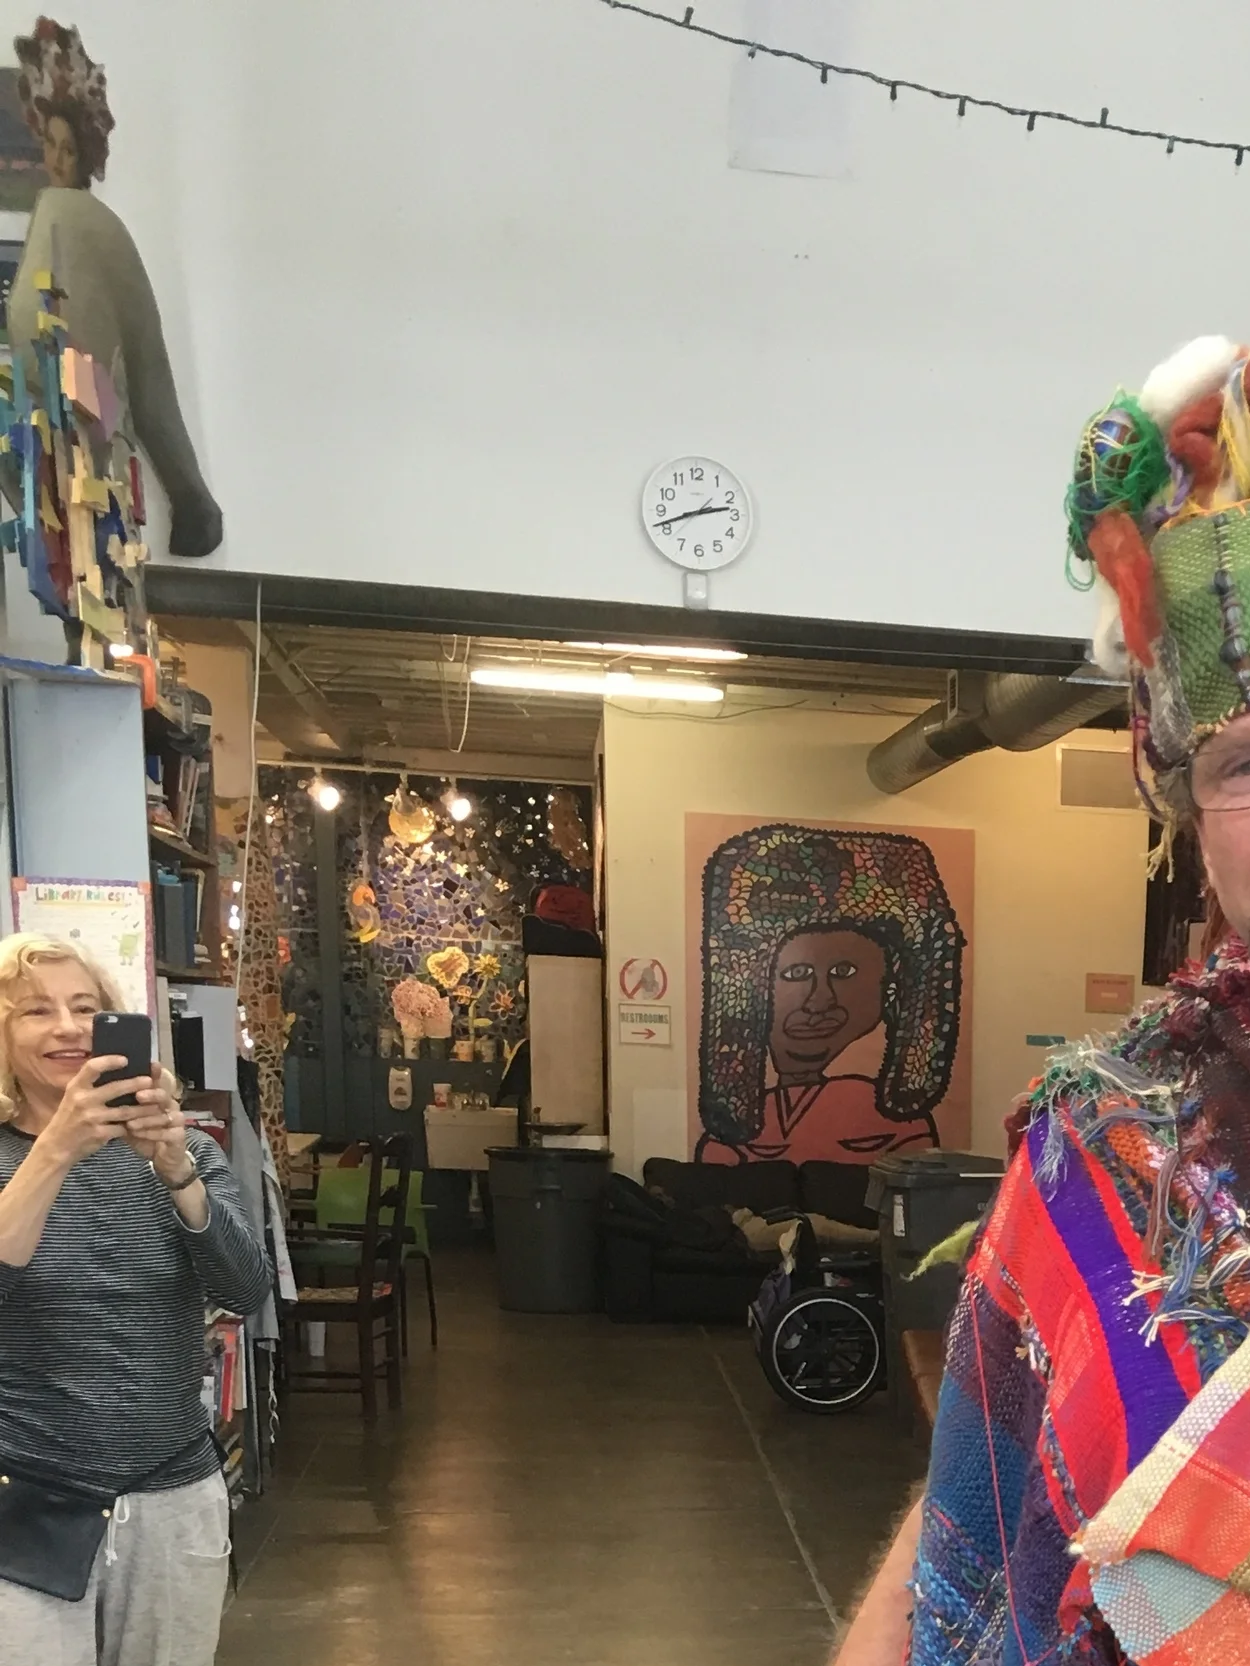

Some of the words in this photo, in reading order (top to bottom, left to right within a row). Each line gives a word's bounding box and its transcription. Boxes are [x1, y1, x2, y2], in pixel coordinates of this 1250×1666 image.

[673, 472, 684, 486] 11
[690, 467, 704, 481] 12
[714, 475, 720, 488] 1
[660, 487, 676, 501] 10
[725, 491, 735, 504] 2
[655, 504, 667, 517] 9
[729, 508, 740, 522] 3
[662, 523, 672, 536] 8
[725, 527, 735, 539] 4
[677, 538, 686, 551] 7
[693, 544, 705, 557] 6
[713, 540, 723, 553] 5
